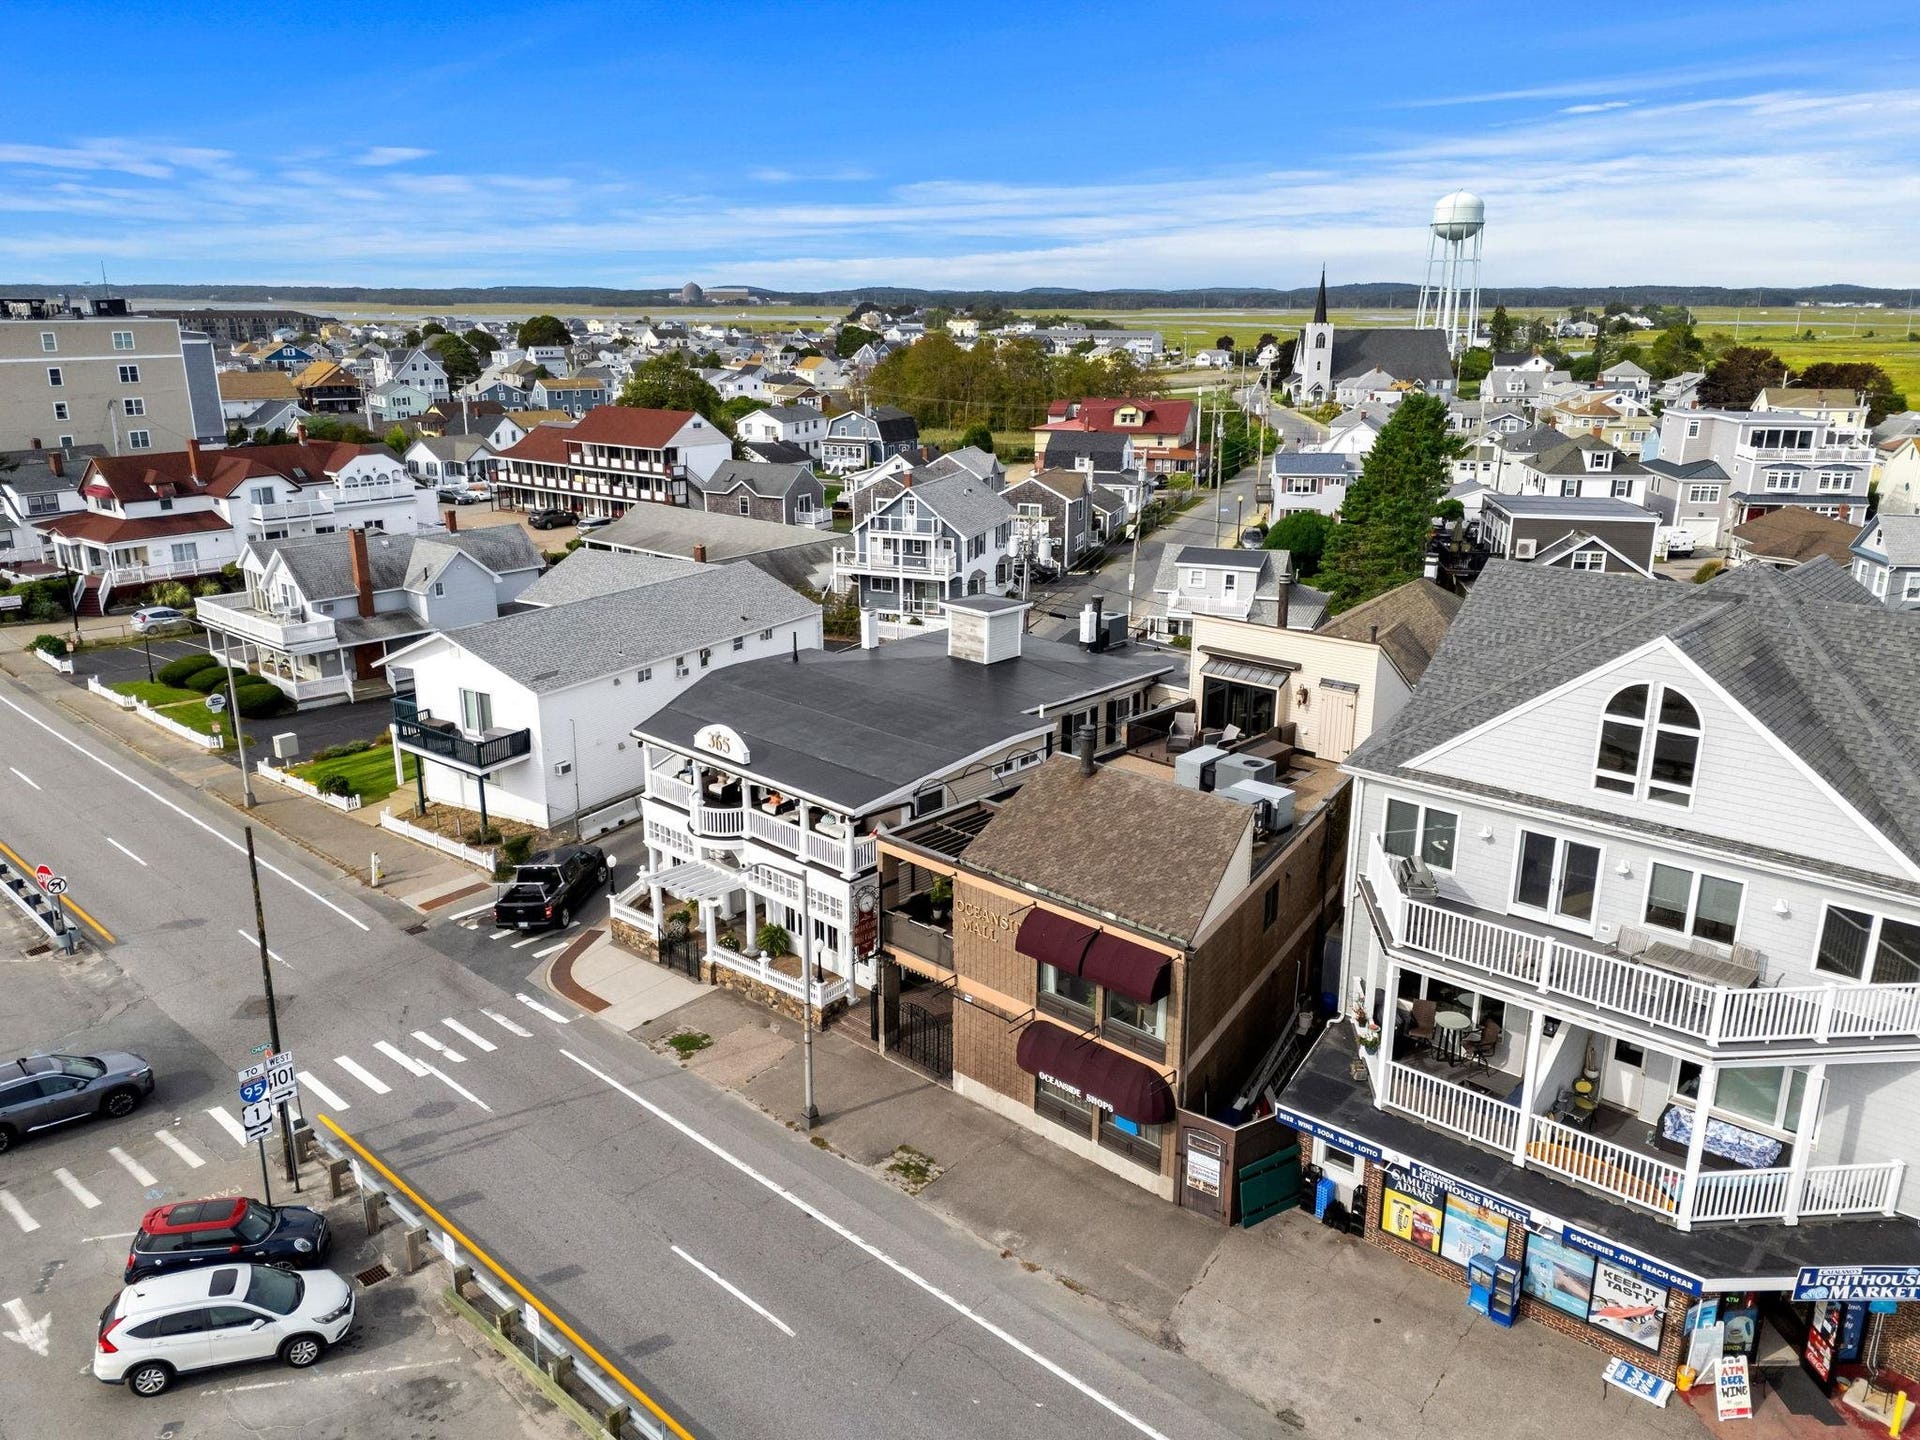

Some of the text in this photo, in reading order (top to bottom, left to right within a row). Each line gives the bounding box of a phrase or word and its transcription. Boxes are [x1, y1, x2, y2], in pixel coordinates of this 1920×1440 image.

[708, 731, 730, 754] 365
[963, 918, 998, 943] MALL
[269, 1053, 289, 1066] WEST
[245, 1067, 258, 1078] TO
[272, 1067, 294, 1087] 101
[244, 1083, 264, 1099] 95
[1039, 1071, 1114, 1113] OCEANSIDE SHOPS
[254, 1108, 260, 1120] 1
[1280, 1112, 1378, 1158] BEER WINE SODA SUBS LOTTO
[1392, 1169, 1439, 1198] SAMUEL
[1395, 1182, 1434, 1205] ADAMS
[1411, 1167, 1529, 1225] LIGHTHOUSE MARKET
[1570, 1233, 1614, 1257] GROCERIES
[1619, 1254, 1637, 1267] ATM
[1642, 1263, 1669, 1280] BEACH
[1670, 1275, 1693, 1290] GEAR
[1603, 1269, 1659, 1299] KEEP IT
[1828, 1285, 1920, 1300] MARKET
[1720, 1375, 1744, 1386] BEER
[1721, 1365, 1744, 1376] ATM
[1721, 1385, 1748, 1398] WINE
